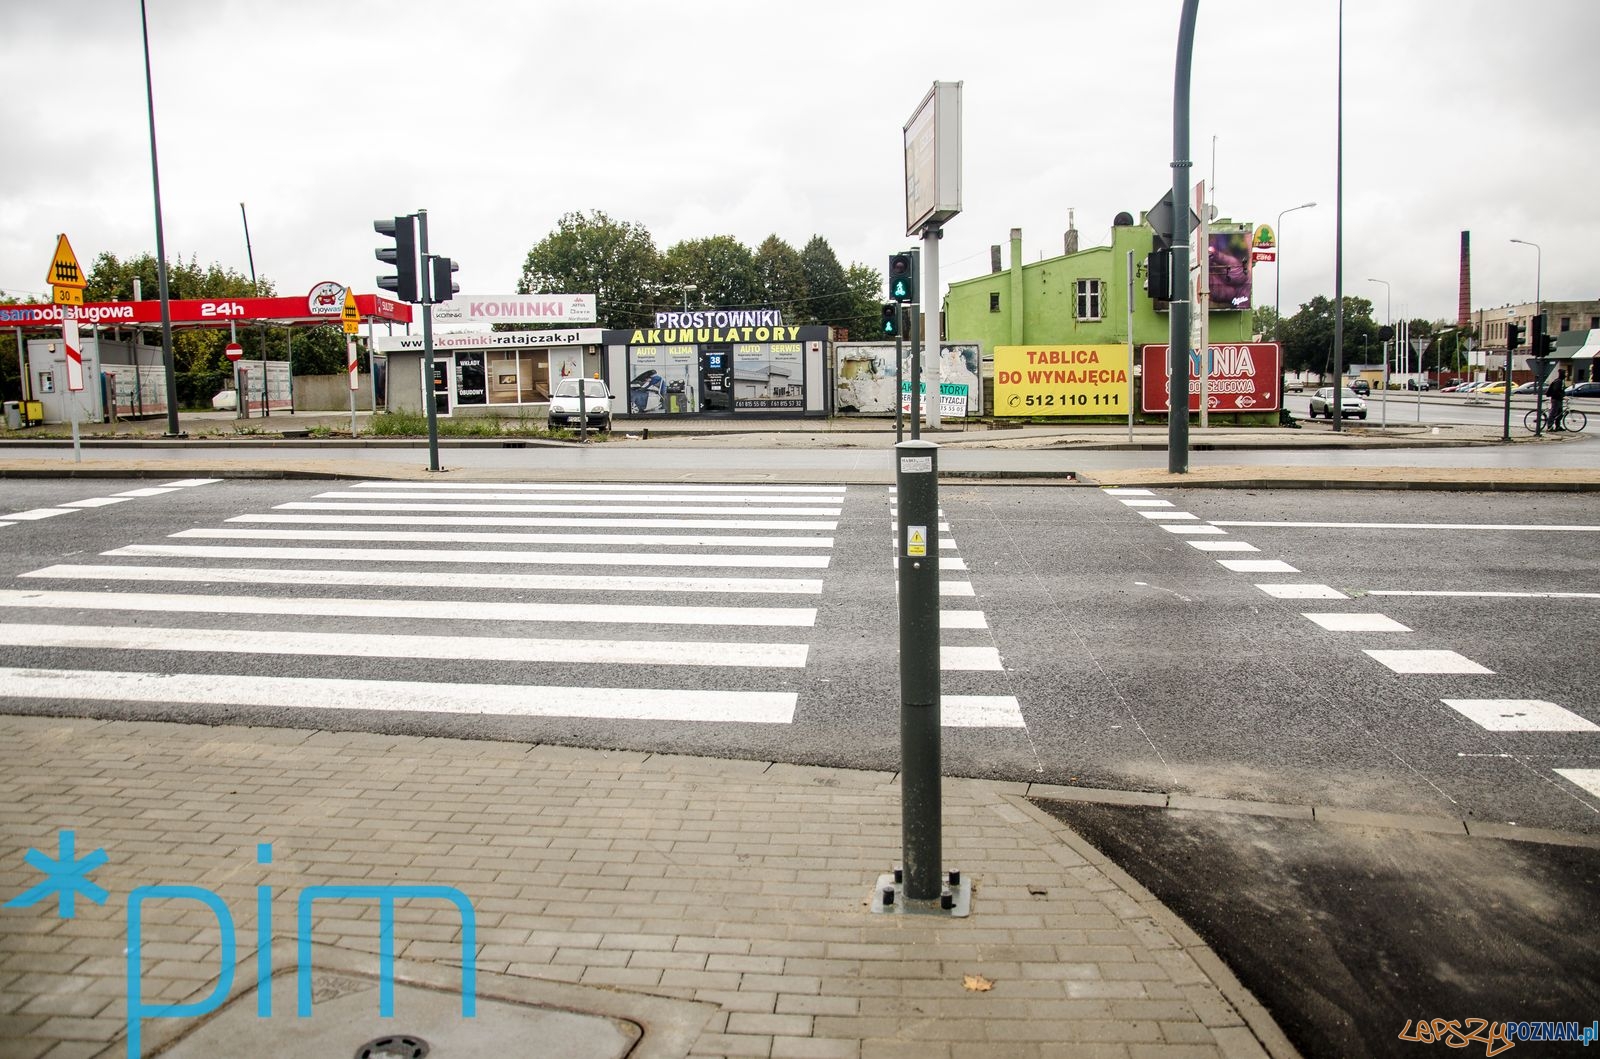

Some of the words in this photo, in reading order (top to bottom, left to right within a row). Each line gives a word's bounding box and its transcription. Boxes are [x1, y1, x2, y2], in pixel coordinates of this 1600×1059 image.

[60, 290, 70, 300] 30
[0, 305, 134, 322] samoobsługowa
[201, 301, 245, 317] 24h
[470, 302, 564, 317] KOMINKI
[656, 311, 780, 328] PROSTOWNIKI
[401, 333, 580, 348] ww.kominki-ratajczak.pl
[630, 327, 801, 344] AKUMULATORY
[636, 347, 657, 355] AUTO
[669, 346, 693, 355] KLIMA
[740, 345, 761, 353] AUTO
[770, 344, 801, 353] SERWIS
[710, 356, 721, 364] 38
[1026, 351, 1100, 365] TABLICA
[1166, 347, 1256, 377] YJNIA
[998, 371, 1023, 385] DO
[1028, 369, 1128, 387] WYNAJĘCIA
[1025, 395, 1057, 406] 512
[1060, 394, 1088, 405] 110
[1093, 394, 1120, 405] 111
